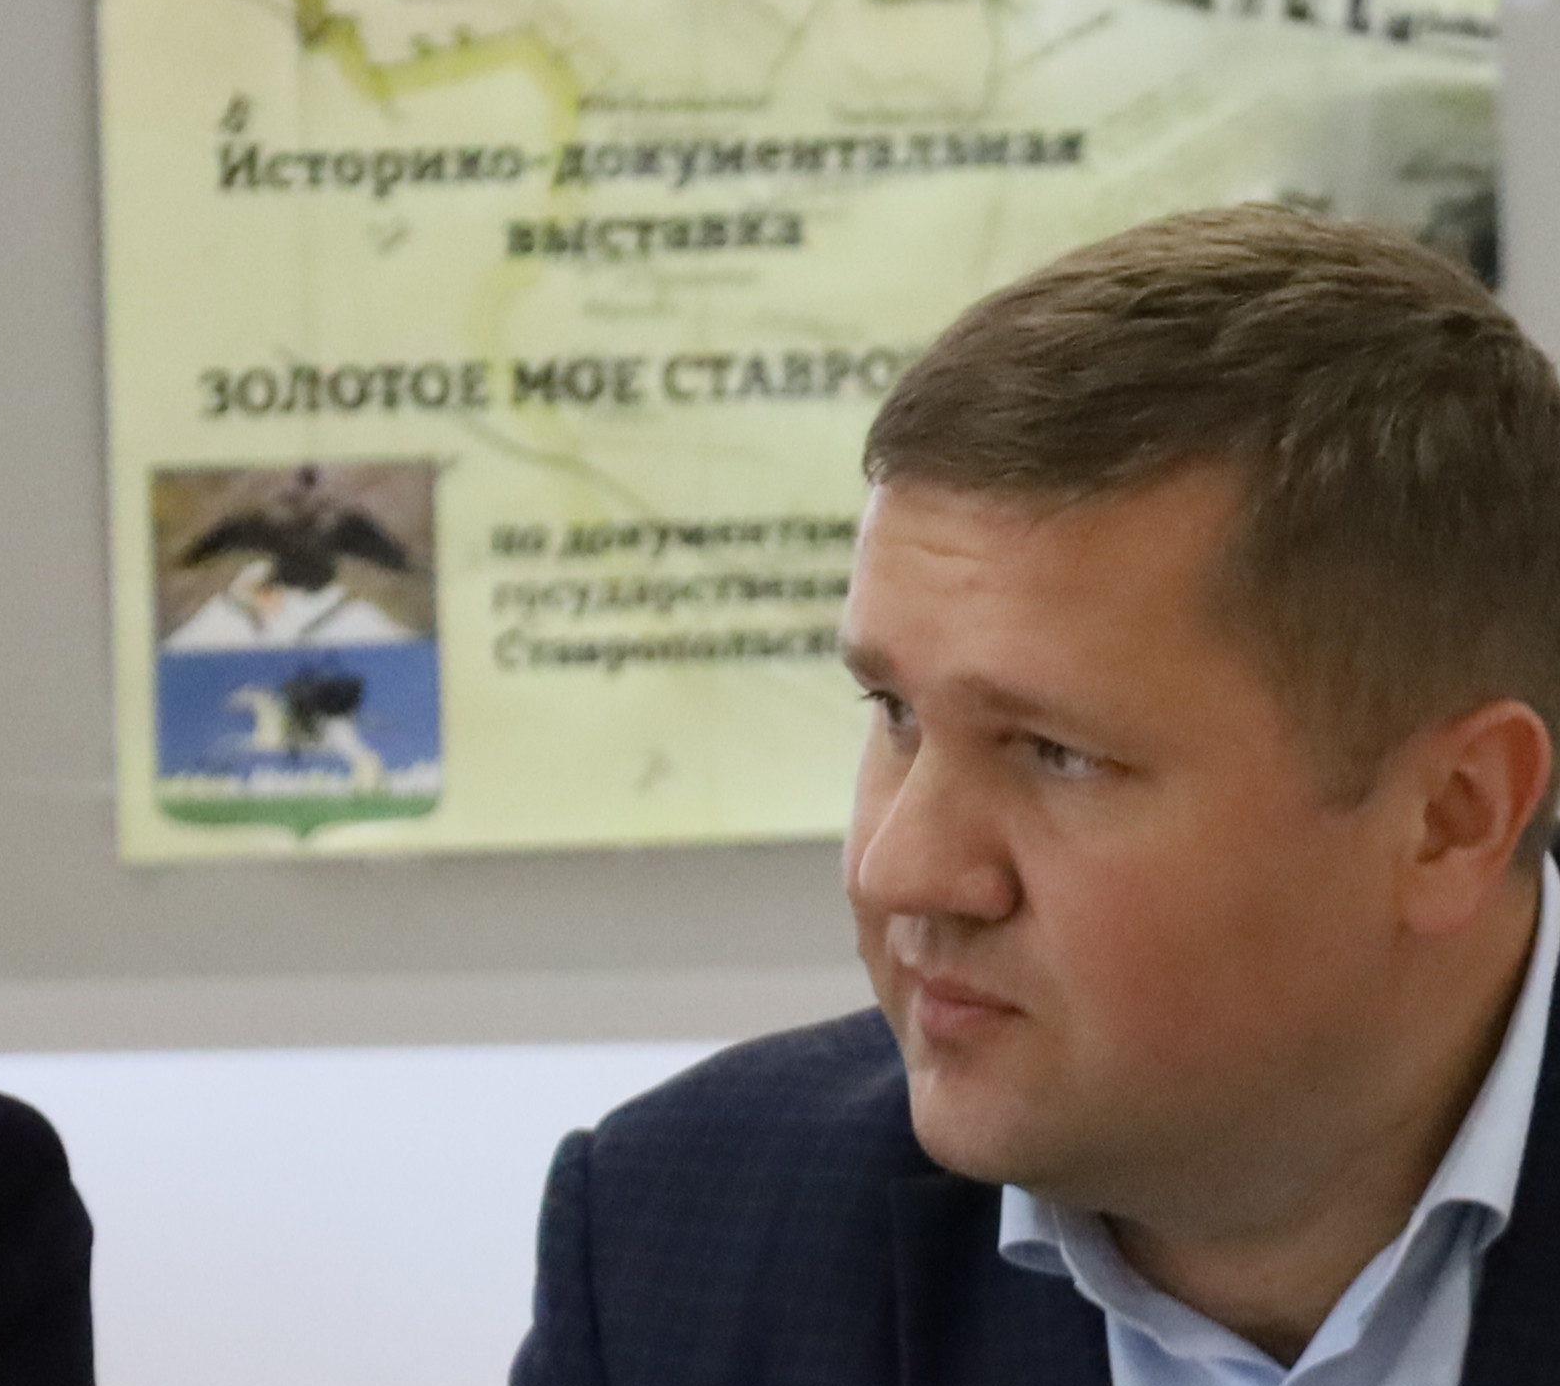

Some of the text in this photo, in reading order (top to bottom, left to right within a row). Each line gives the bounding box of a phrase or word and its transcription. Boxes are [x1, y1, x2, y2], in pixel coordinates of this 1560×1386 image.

[506, 214, 804, 261] выставка
[199, 346, 924, 415] ЗОЛОТОЕ МОЕ СТАВРО
